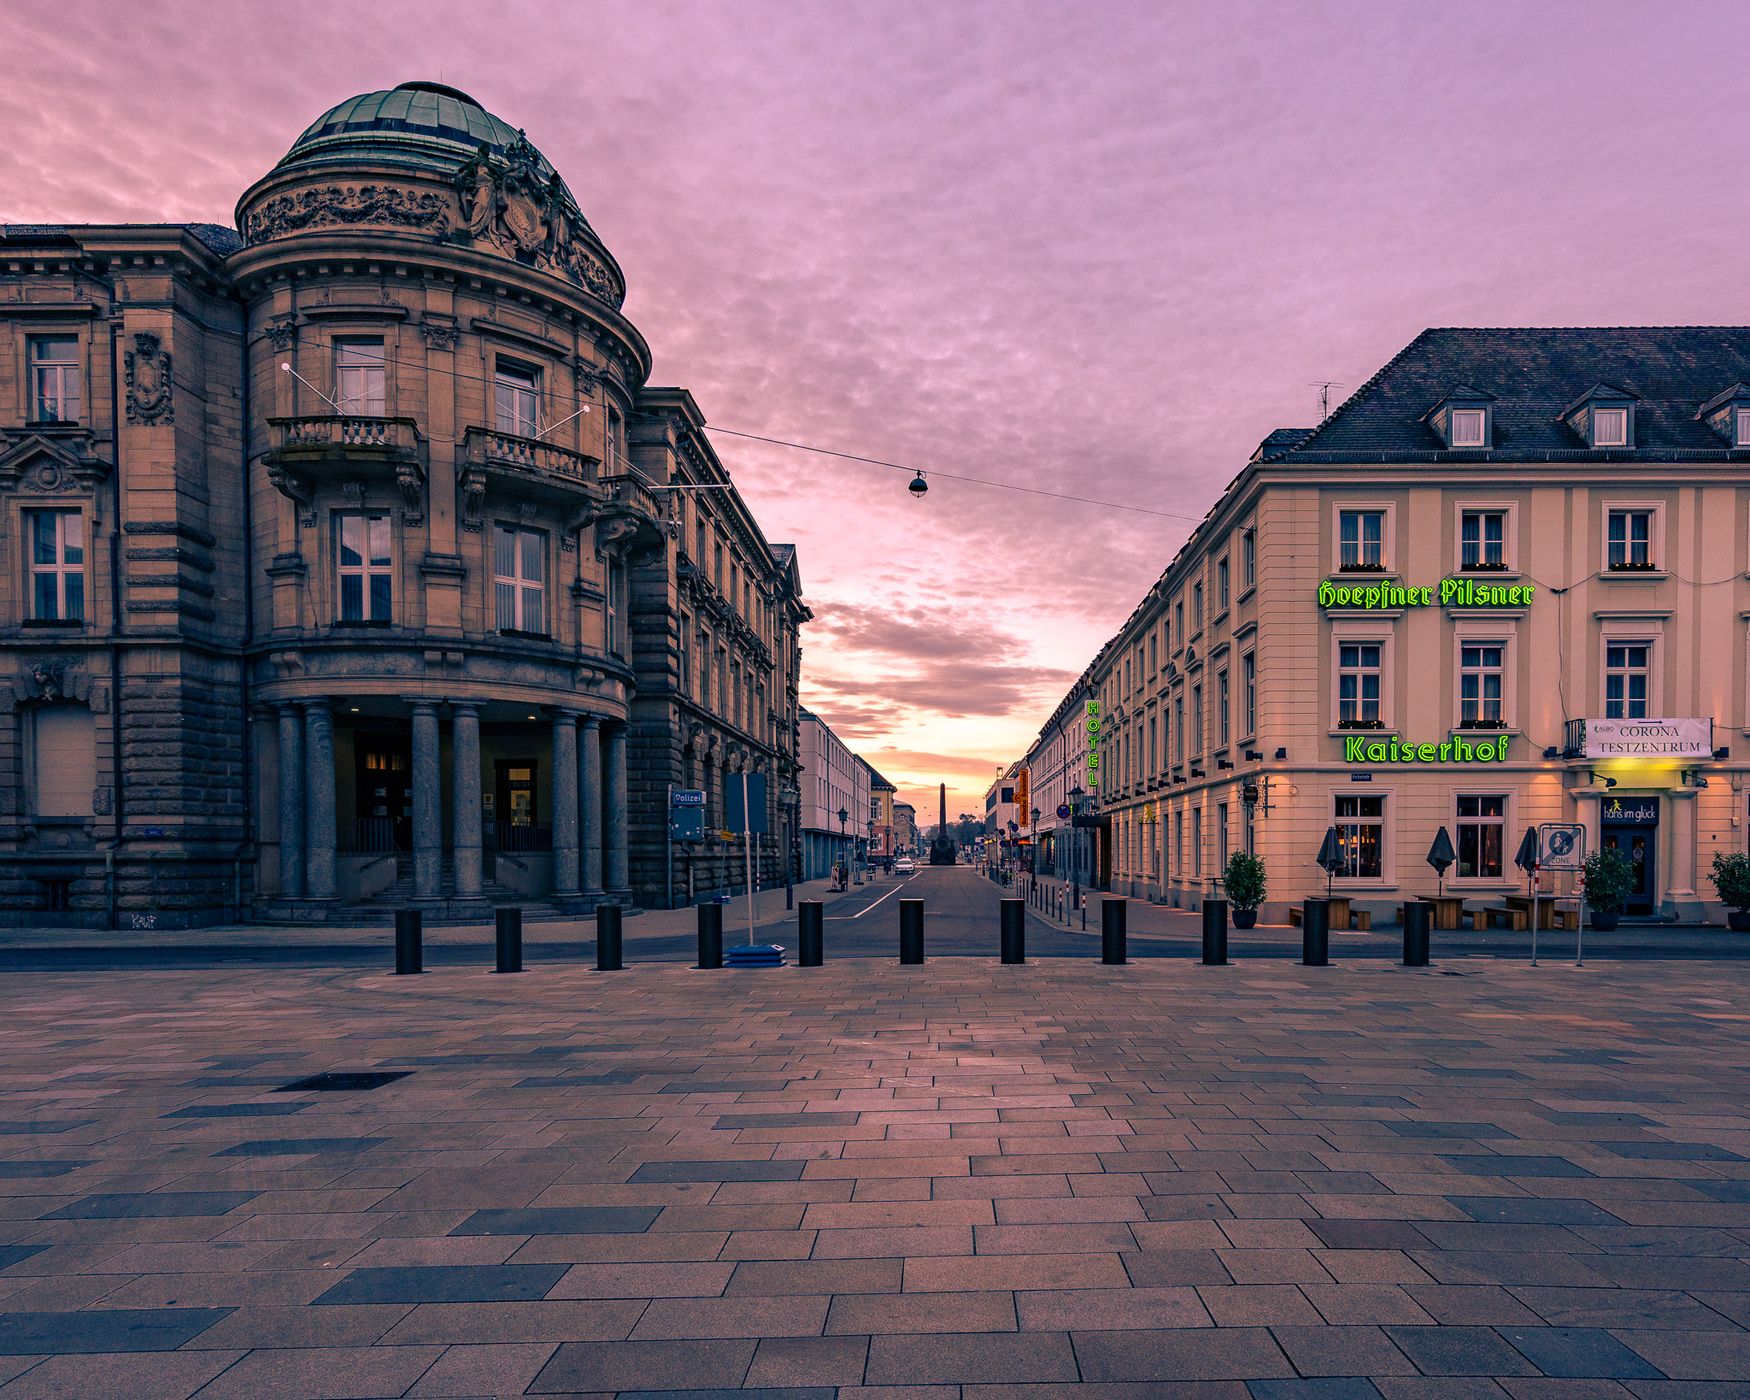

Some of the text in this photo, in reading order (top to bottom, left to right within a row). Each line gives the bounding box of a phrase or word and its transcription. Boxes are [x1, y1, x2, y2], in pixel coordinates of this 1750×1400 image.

[1318, 579, 1535, 609] Hoepfner Pilsner
[1620, 726, 1680, 737] CORONA
[1086, 701, 1100, 787] HOTEL
[1345, 735, 1509, 762] Kaiserhof
[1599, 742, 1701, 753] TESTZENTRUM
[675, 794, 701, 802] Polizei
[1603, 805, 1656, 822] hans im glück
